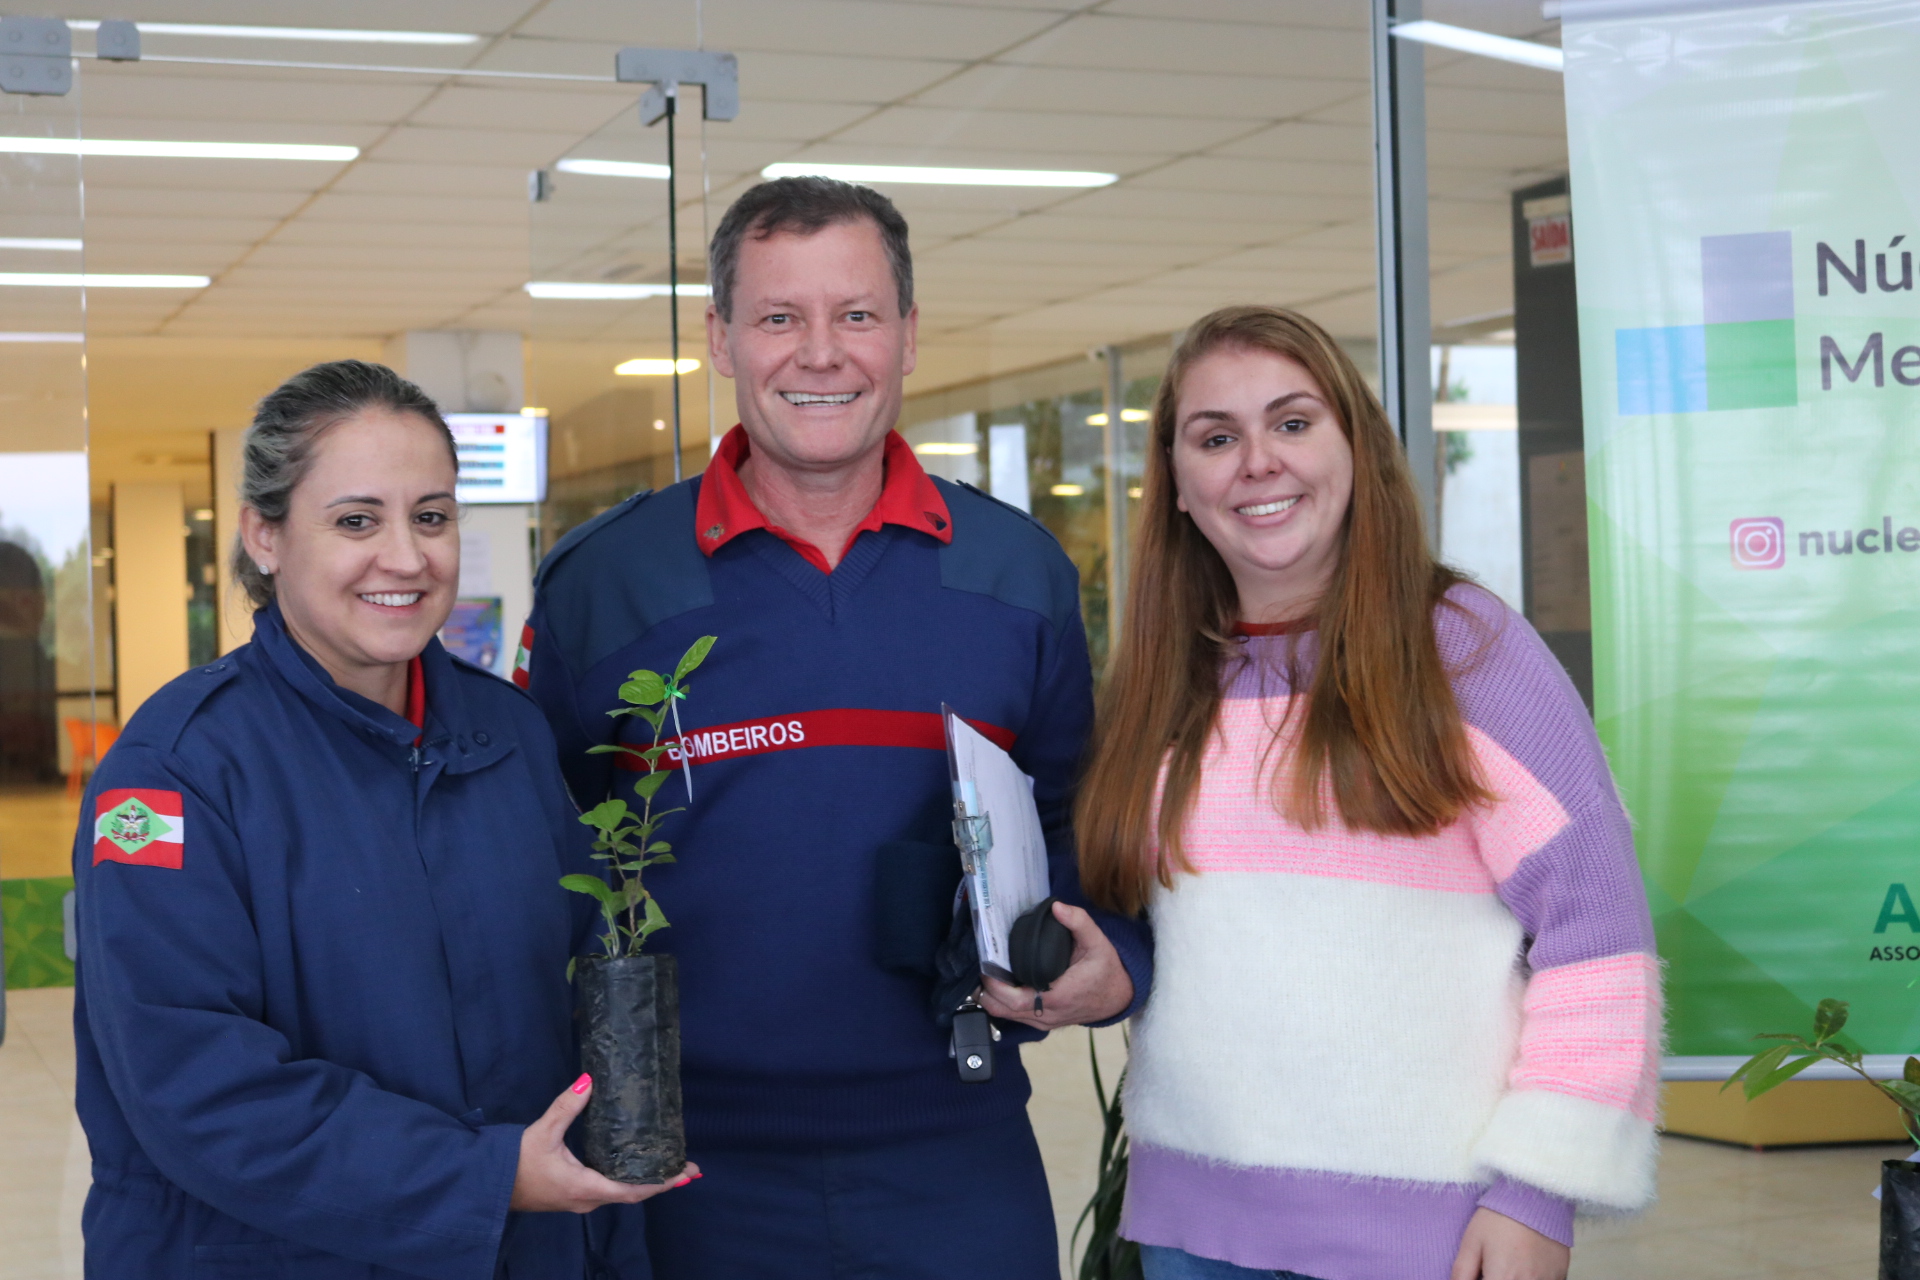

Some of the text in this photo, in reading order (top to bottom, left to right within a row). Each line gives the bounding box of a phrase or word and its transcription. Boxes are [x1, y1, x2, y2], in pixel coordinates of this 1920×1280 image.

[1816, 234, 1920, 297] Nú
[1819, 332, 1920, 391] Me
[1798, 515, 1920, 556] nucle
[664, 720, 805, 761] BOMBEIROS
[1873, 883, 1920, 934] A
[1869, 946, 1920, 961] ASSO
